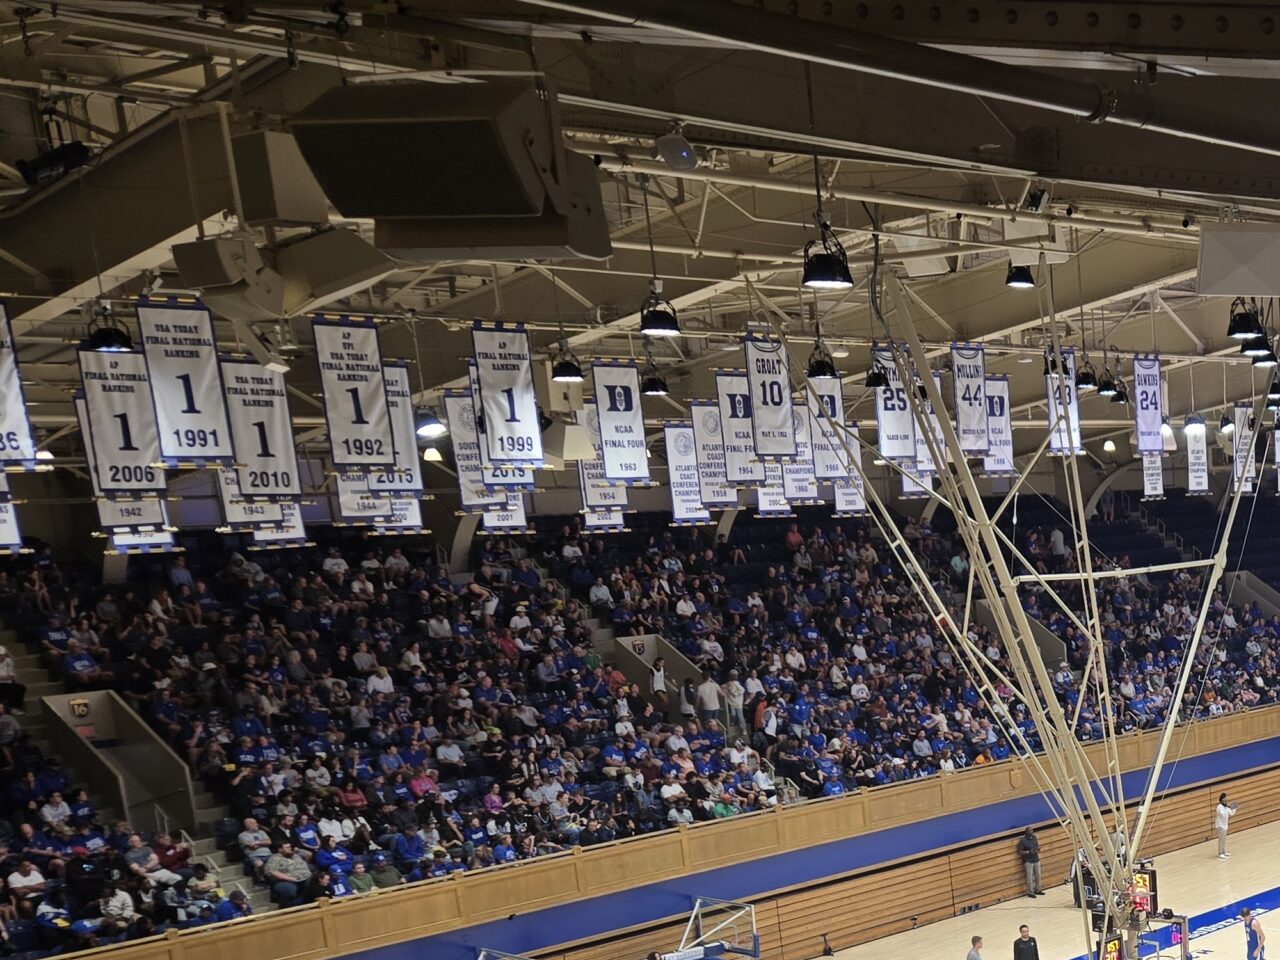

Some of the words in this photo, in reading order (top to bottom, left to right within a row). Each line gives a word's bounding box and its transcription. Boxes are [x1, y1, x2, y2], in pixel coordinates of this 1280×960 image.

[154, 324, 171, 333] USA
[174, 325, 198, 334] TODAY
[145, 336, 169, 345] FINAL
[171, 337, 212, 346] NATIONAL
[164, 349, 200, 358] RANKING
[330, 352, 345, 361] USA
[346, 352, 368, 361] TODAY
[321, 361, 344, 371] FINAL
[345, 364, 380, 373] NATIONAL
[756, 358, 782, 375] GROAT
[84, 371, 108, 380] FINAL
[110, 373, 147, 381] NATIONAL
[251, 377, 274, 385] TODAY
[336, 373, 369, 382] RANKING
[1137, 374, 1159, 386] DAWKINS
[101, 384, 135, 393] RANKING
[175, 373, 201, 414] 1
[227, 387, 249, 396] FINAL
[250, 388, 285, 397] NATIONAL
[760, 381, 784, 406] 10
[883, 387, 908, 411] 25
[961, 384, 982, 407] 44
[242, 399, 274, 408] RANKING
[345, 387, 370, 424] 1
[501, 388, 521, 422] 1
[1140, 391, 1159, 411] 24
[113, 413, 139, 451] 1
[614, 425, 634, 434] NCAA
[173, 428, 220, 447] 1991
[252, 421, 276, 457] 1
[342, 438, 385, 456] 1992
[498, 436, 534, 452] 1999
[605, 440, 626, 448] FINAL
[628, 440, 645, 448] FOUR
[726, 445, 743, 453] FINAL
[814, 443, 831, 451] FINAL
[620, 463, 637, 471] 1963
[738, 466, 754, 475] 1964
[109, 465, 155, 483] 2006
[249, 470, 291, 488] 2010
[701, 471, 727, 479] CHAMPIO
[119, 508, 143, 517] 1942
[243, 505, 265, 515] 1943
[75, 705, 88, 716] 16
